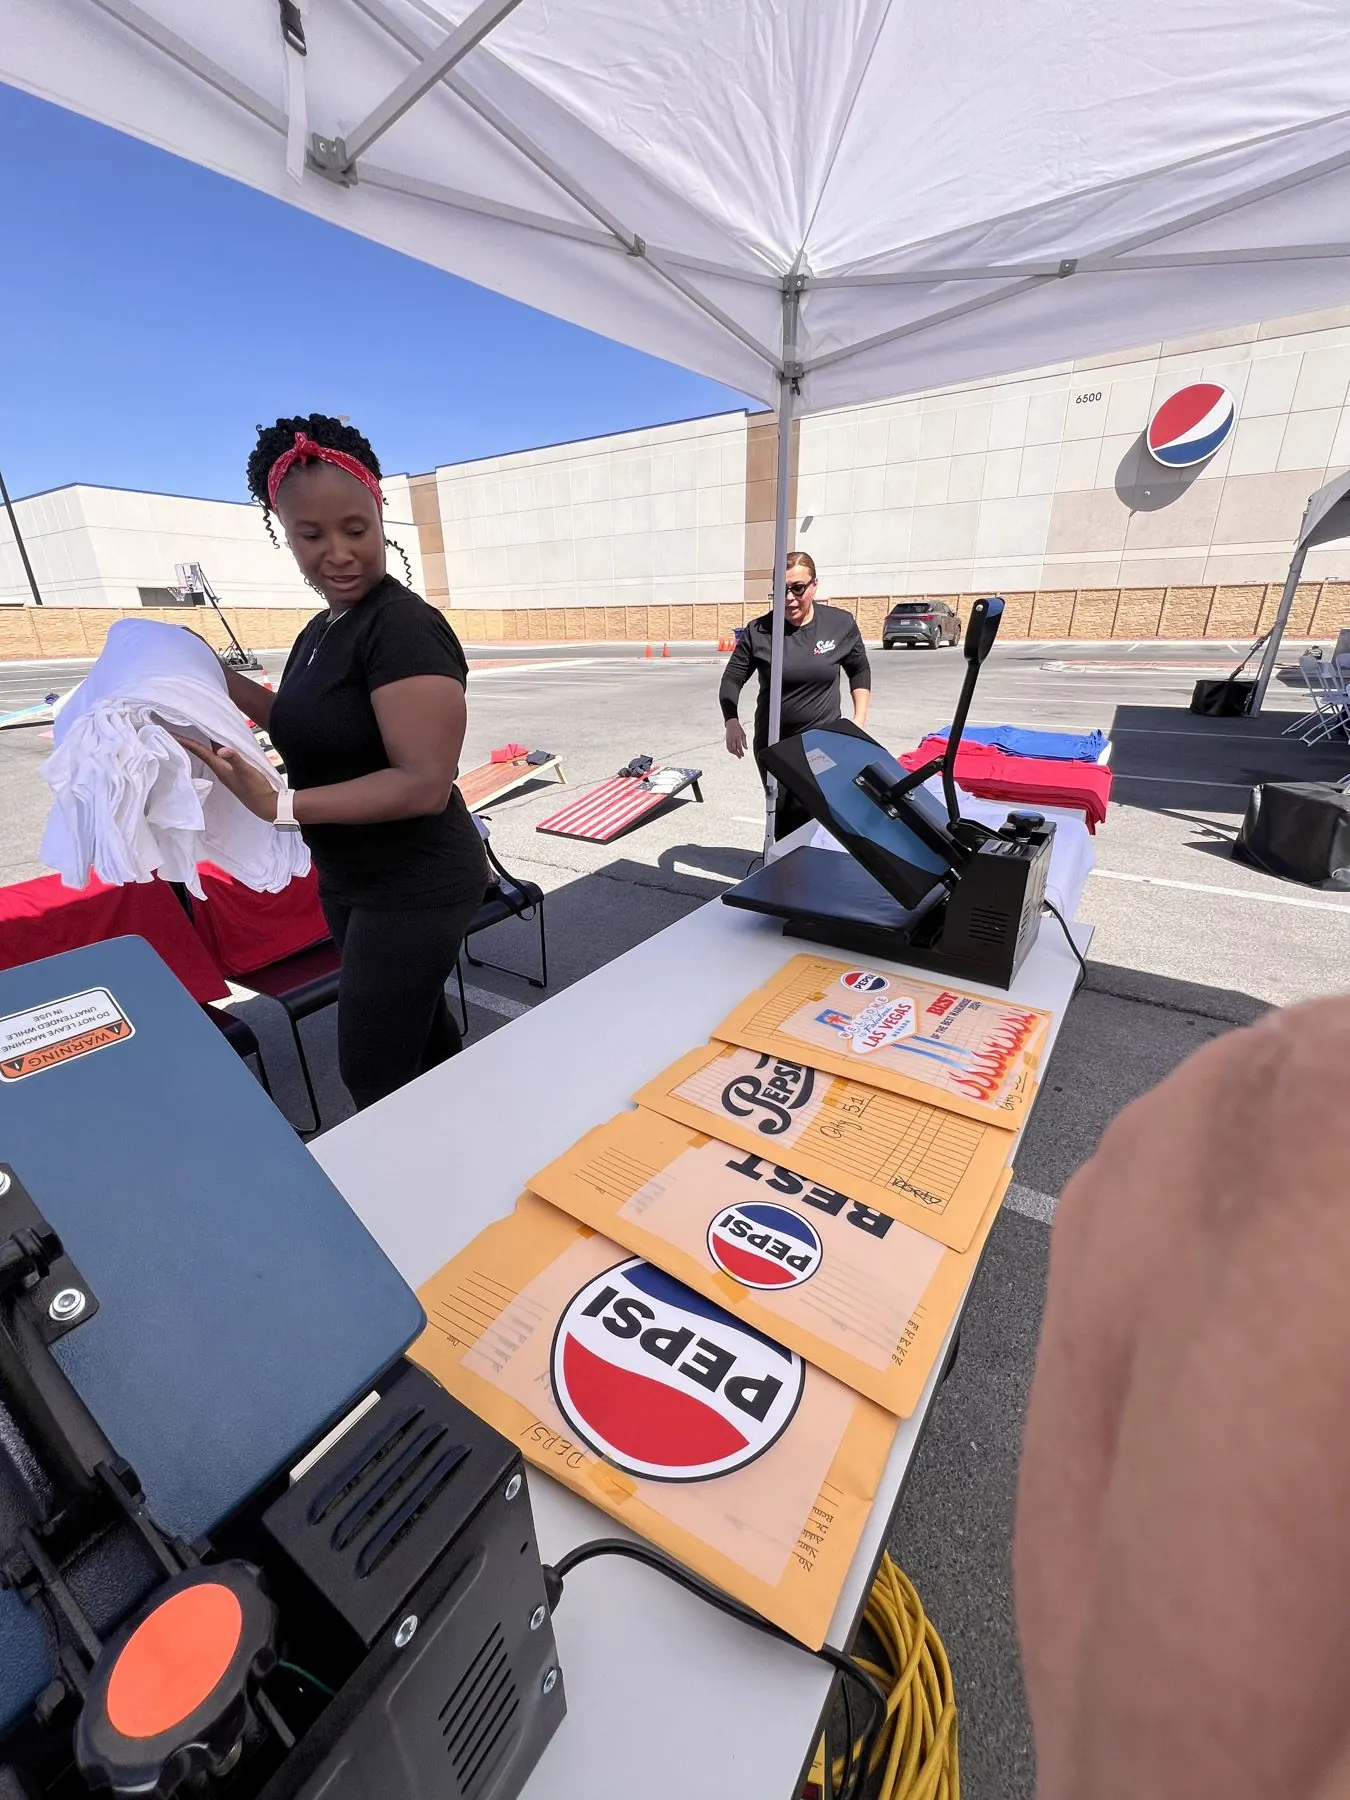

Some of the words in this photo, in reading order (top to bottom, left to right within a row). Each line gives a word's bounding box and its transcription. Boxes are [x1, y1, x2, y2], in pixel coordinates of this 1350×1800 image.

[1076, 392, 1102, 404] 6500
[854, 974, 876, 989] PEPSI
[53, 1008, 63, 1016] IN
[926, 992, 958, 1016] BEST
[33, 1013, 52, 1022] USE
[38, 1006, 97, 1030] UNATTENDED
[75, 1016, 96, 1027] NOT
[97, 1011, 110, 1020] DO
[840, 997, 887, 1038] WELCOME
[862, 1030, 887, 1048] LAS
[878, 1003, 912, 1029] VEGAS
[6, 1027, 37, 1040] WHILE
[49, 1022, 75, 1036] LEAVE
[1, 1030, 48, 1053] MACHINE
[28, 1033, 110, 1067] WARNING
[820, 1119, 862, 1139] Qty
[725, 1154, 894, 1239] BEST
[718, 1214, 812, 1272] PEPSI
[581, 1286, 783, 1423] PEPSI
